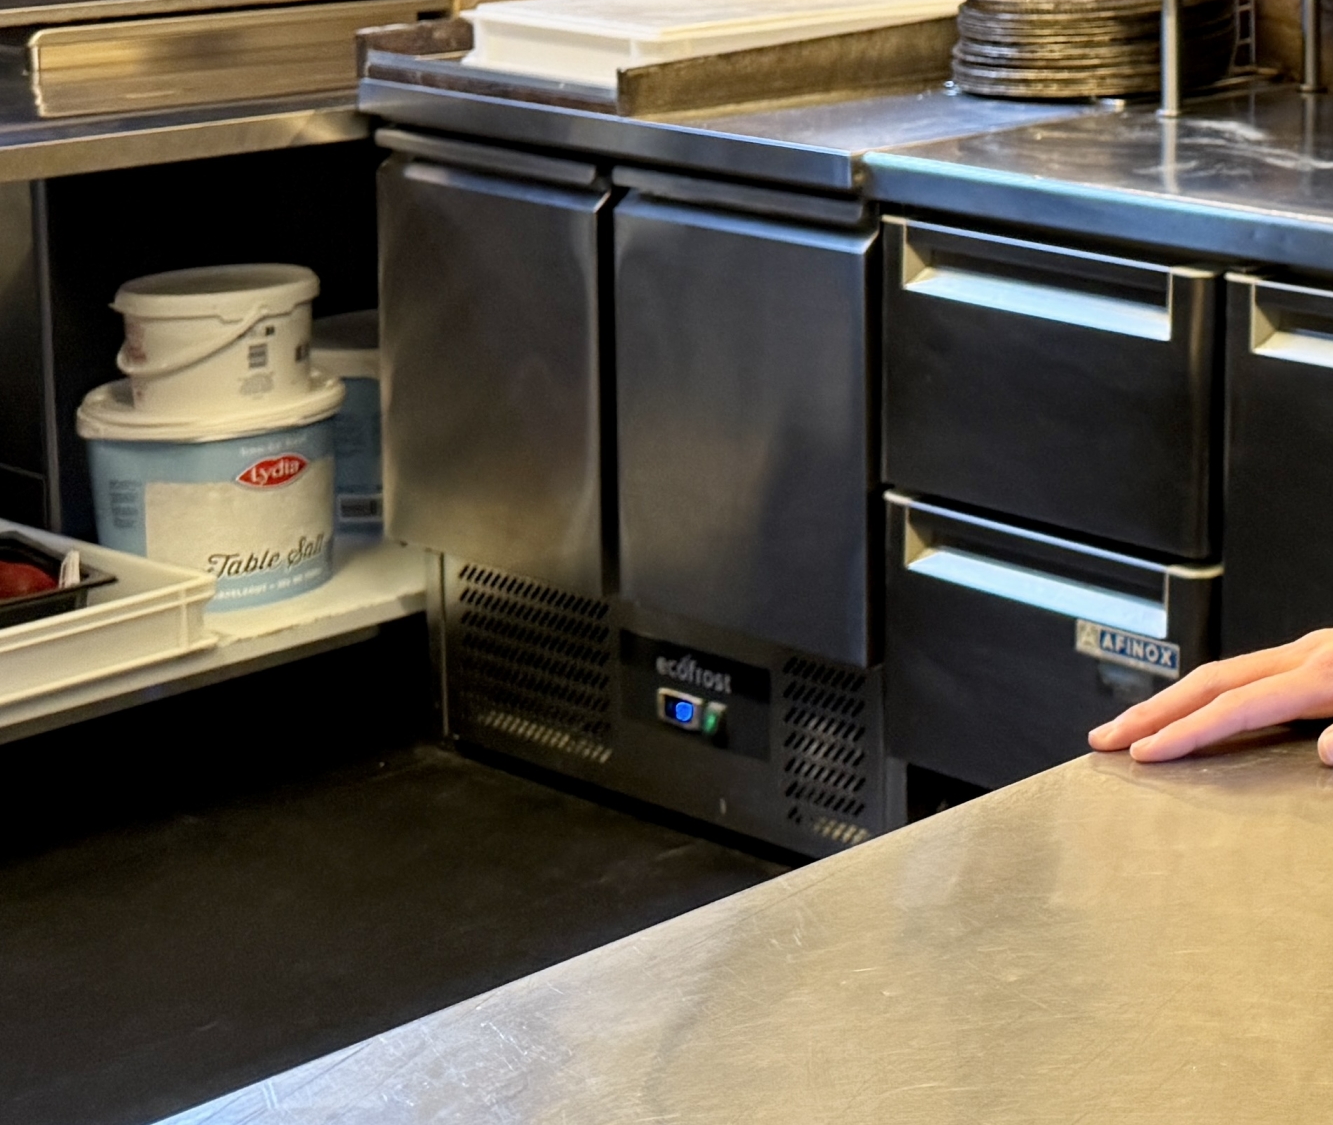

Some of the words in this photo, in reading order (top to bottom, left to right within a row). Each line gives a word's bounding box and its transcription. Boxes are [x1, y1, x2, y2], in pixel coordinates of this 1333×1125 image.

[249, 457, 301, 486] Lydia
[207, 547, 282, 580] Table
[1099, 630, 1175, 669] AFINOX
[655, 654, 733, 693] ecofrost
